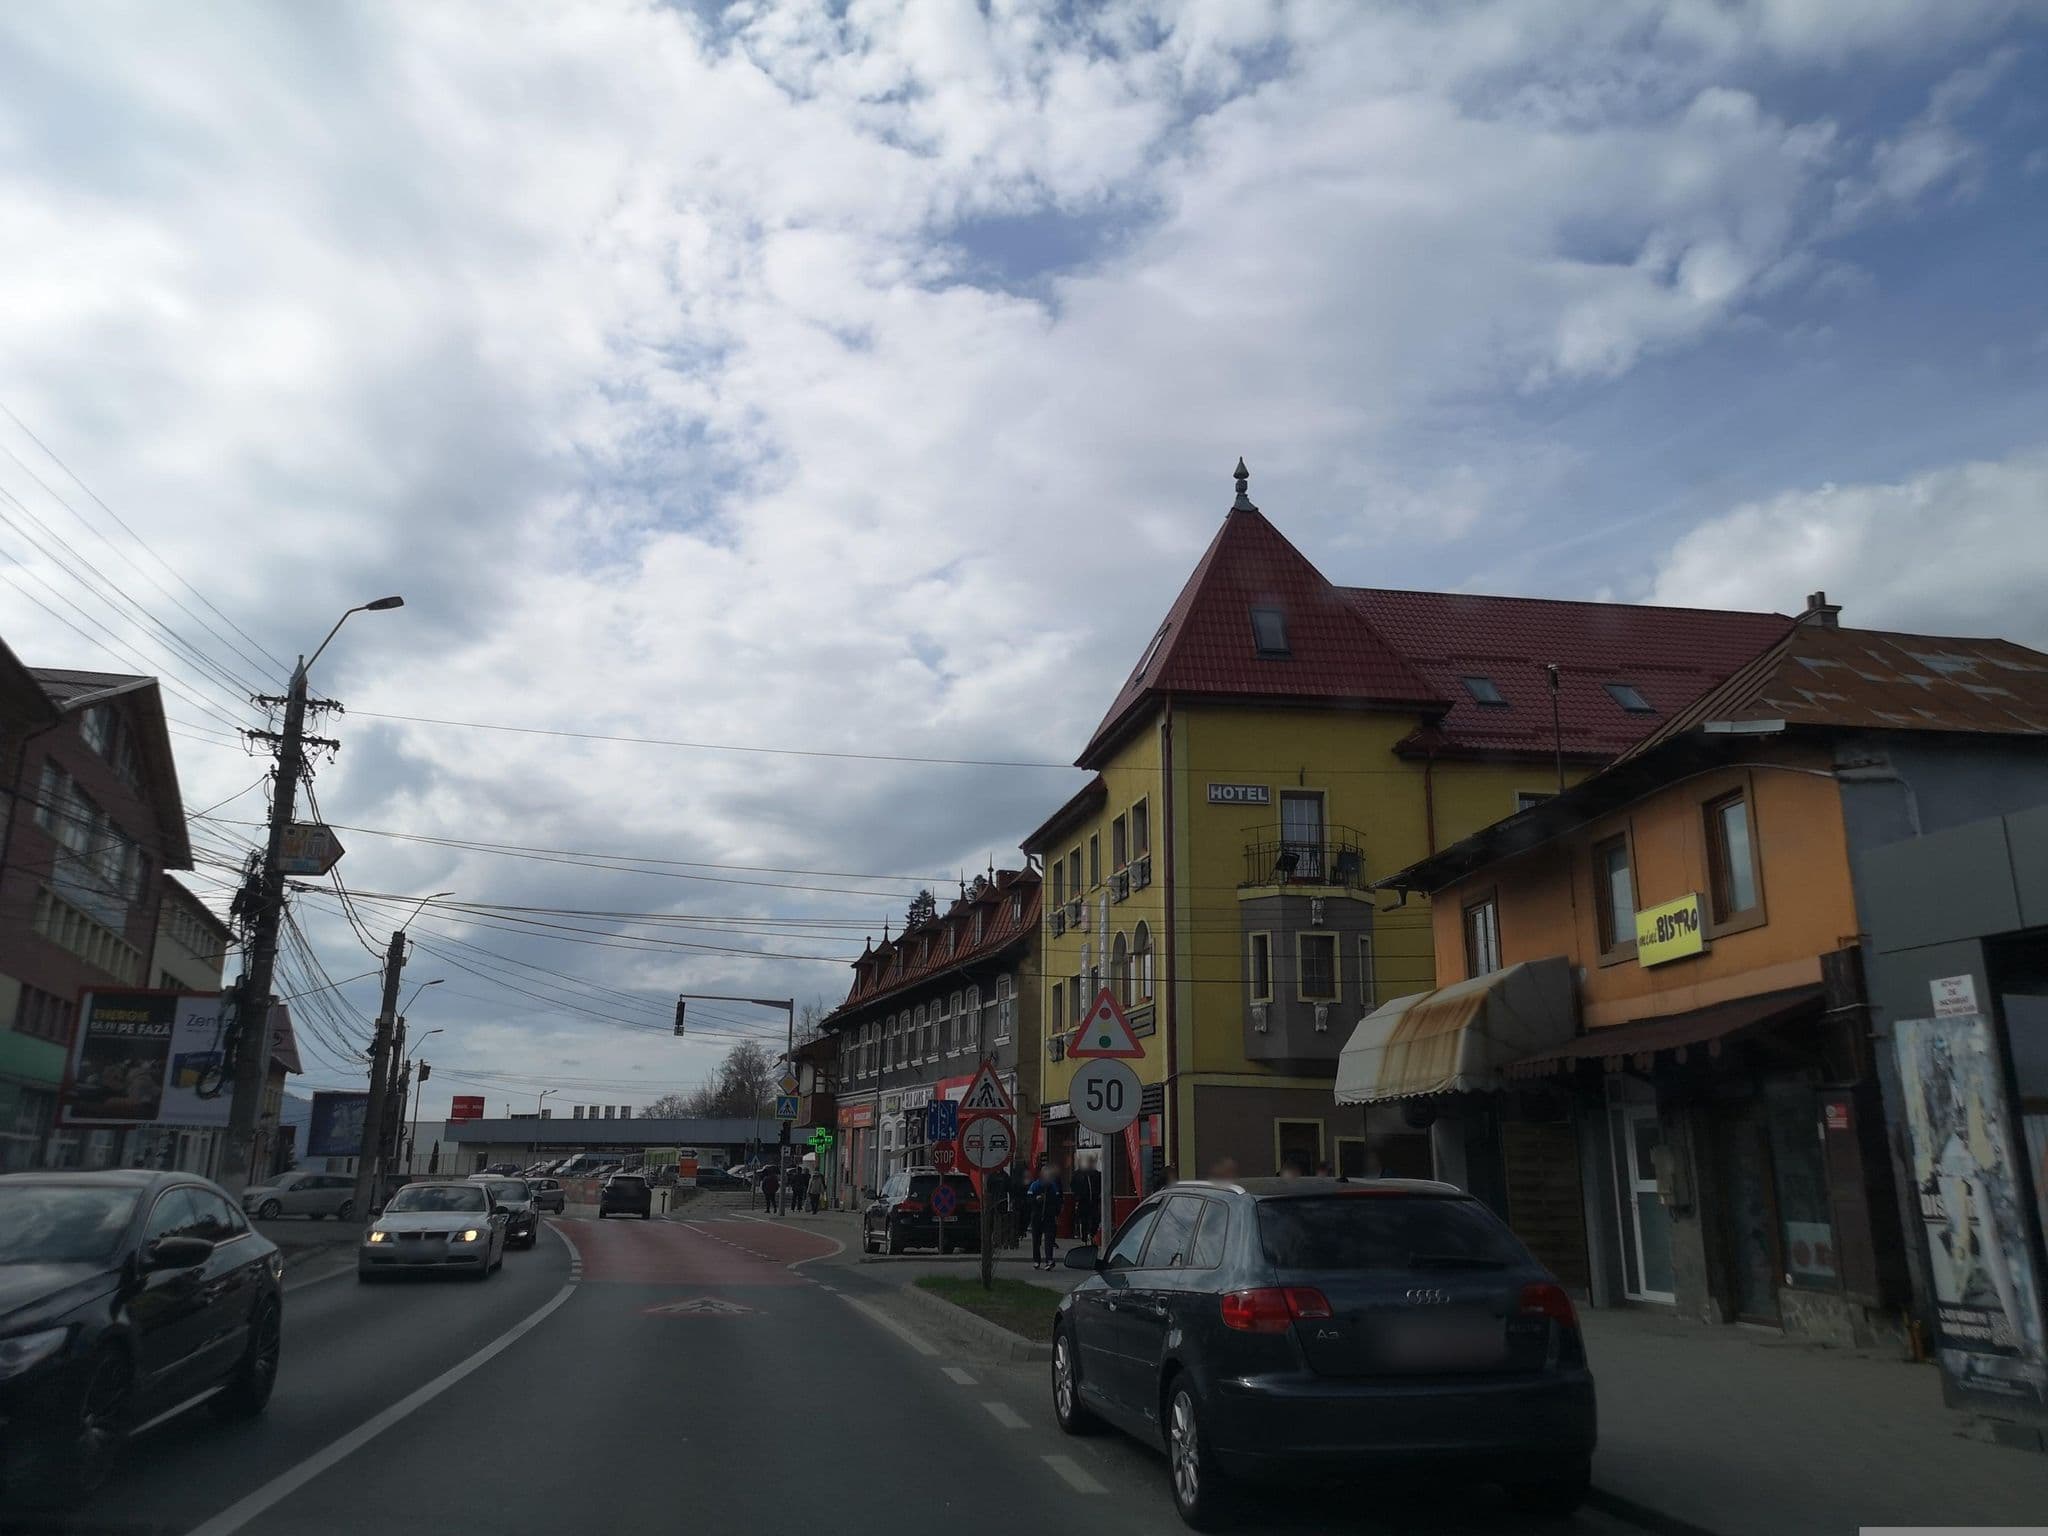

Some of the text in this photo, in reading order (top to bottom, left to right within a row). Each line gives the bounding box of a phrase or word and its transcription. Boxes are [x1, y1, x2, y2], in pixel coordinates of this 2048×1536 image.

[1210, 785, 1268, 801] HOTEL
[1656, 908, 1699, 943] BISTRO
[1087, 1078, 1123, 1112] 50
[934, 1150, 954, 1164] STOP
